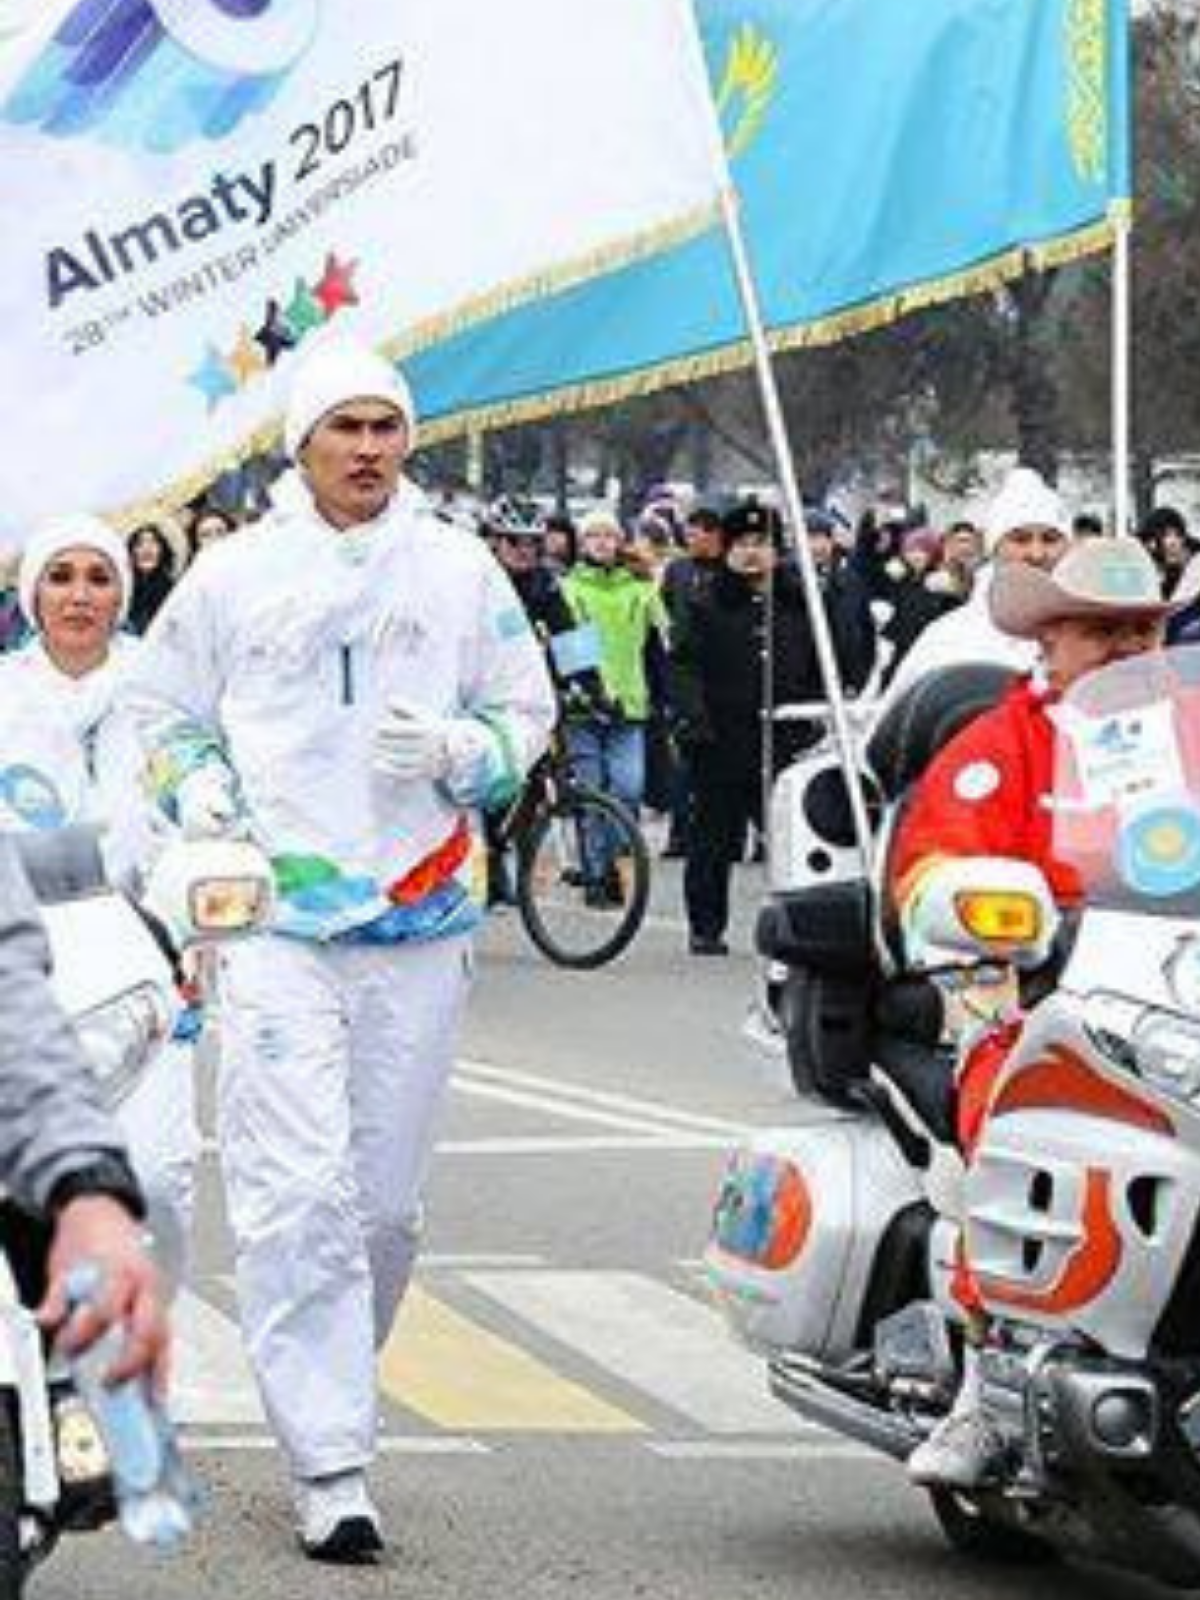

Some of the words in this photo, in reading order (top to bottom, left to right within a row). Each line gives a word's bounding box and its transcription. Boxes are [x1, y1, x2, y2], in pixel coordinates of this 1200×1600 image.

[46, 160, 277, 308] Almaty
[288, 59, 402, 182] 2017
[137, 246, 257, 317] WINTER
